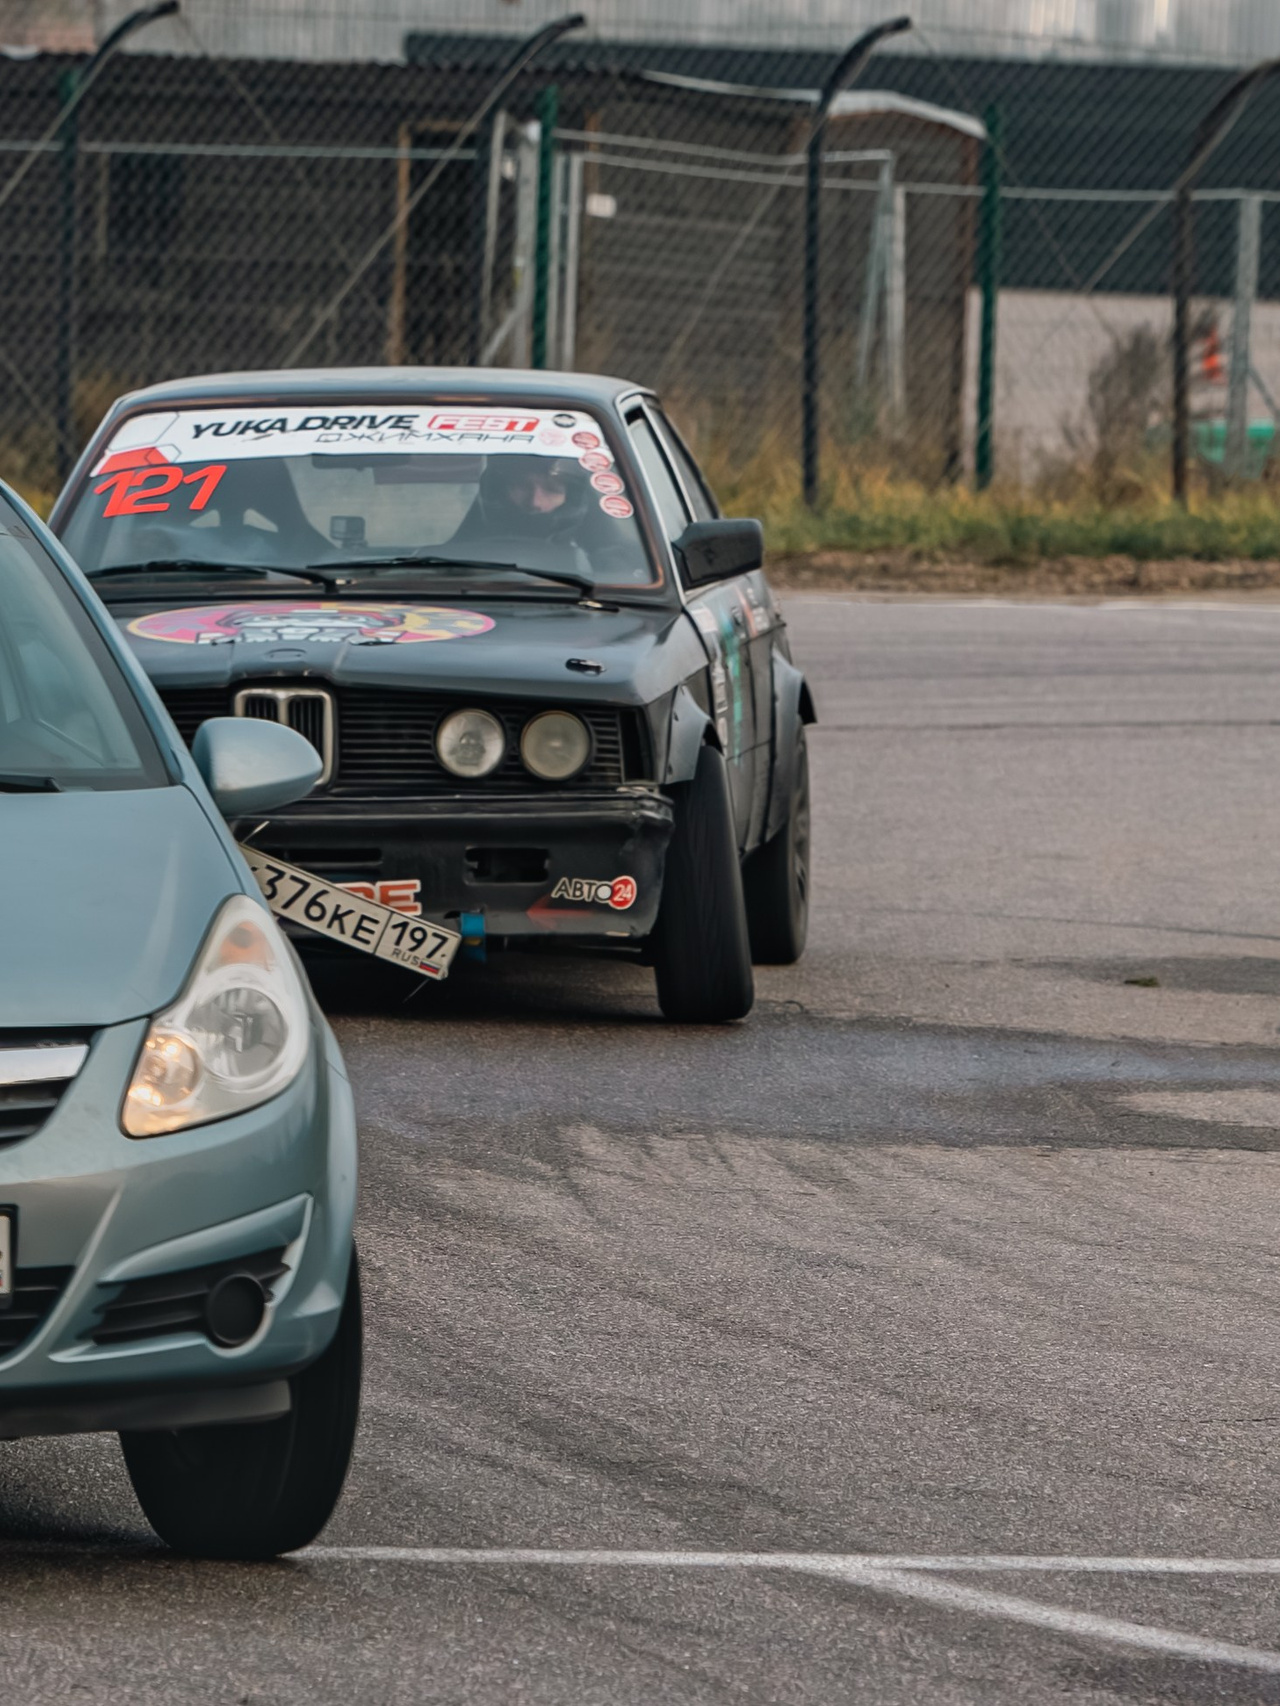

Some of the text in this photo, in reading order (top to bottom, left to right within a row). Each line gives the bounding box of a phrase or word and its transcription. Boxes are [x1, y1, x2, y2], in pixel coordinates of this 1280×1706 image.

[192, 417, 288, 439] YUKA
[294, 414, 420, 431] DRIVE
[93, 464, 228, 518] 121
[251, 864, 449, 961] 376КЕ 197
[391, 947, 420, 967] RUS
